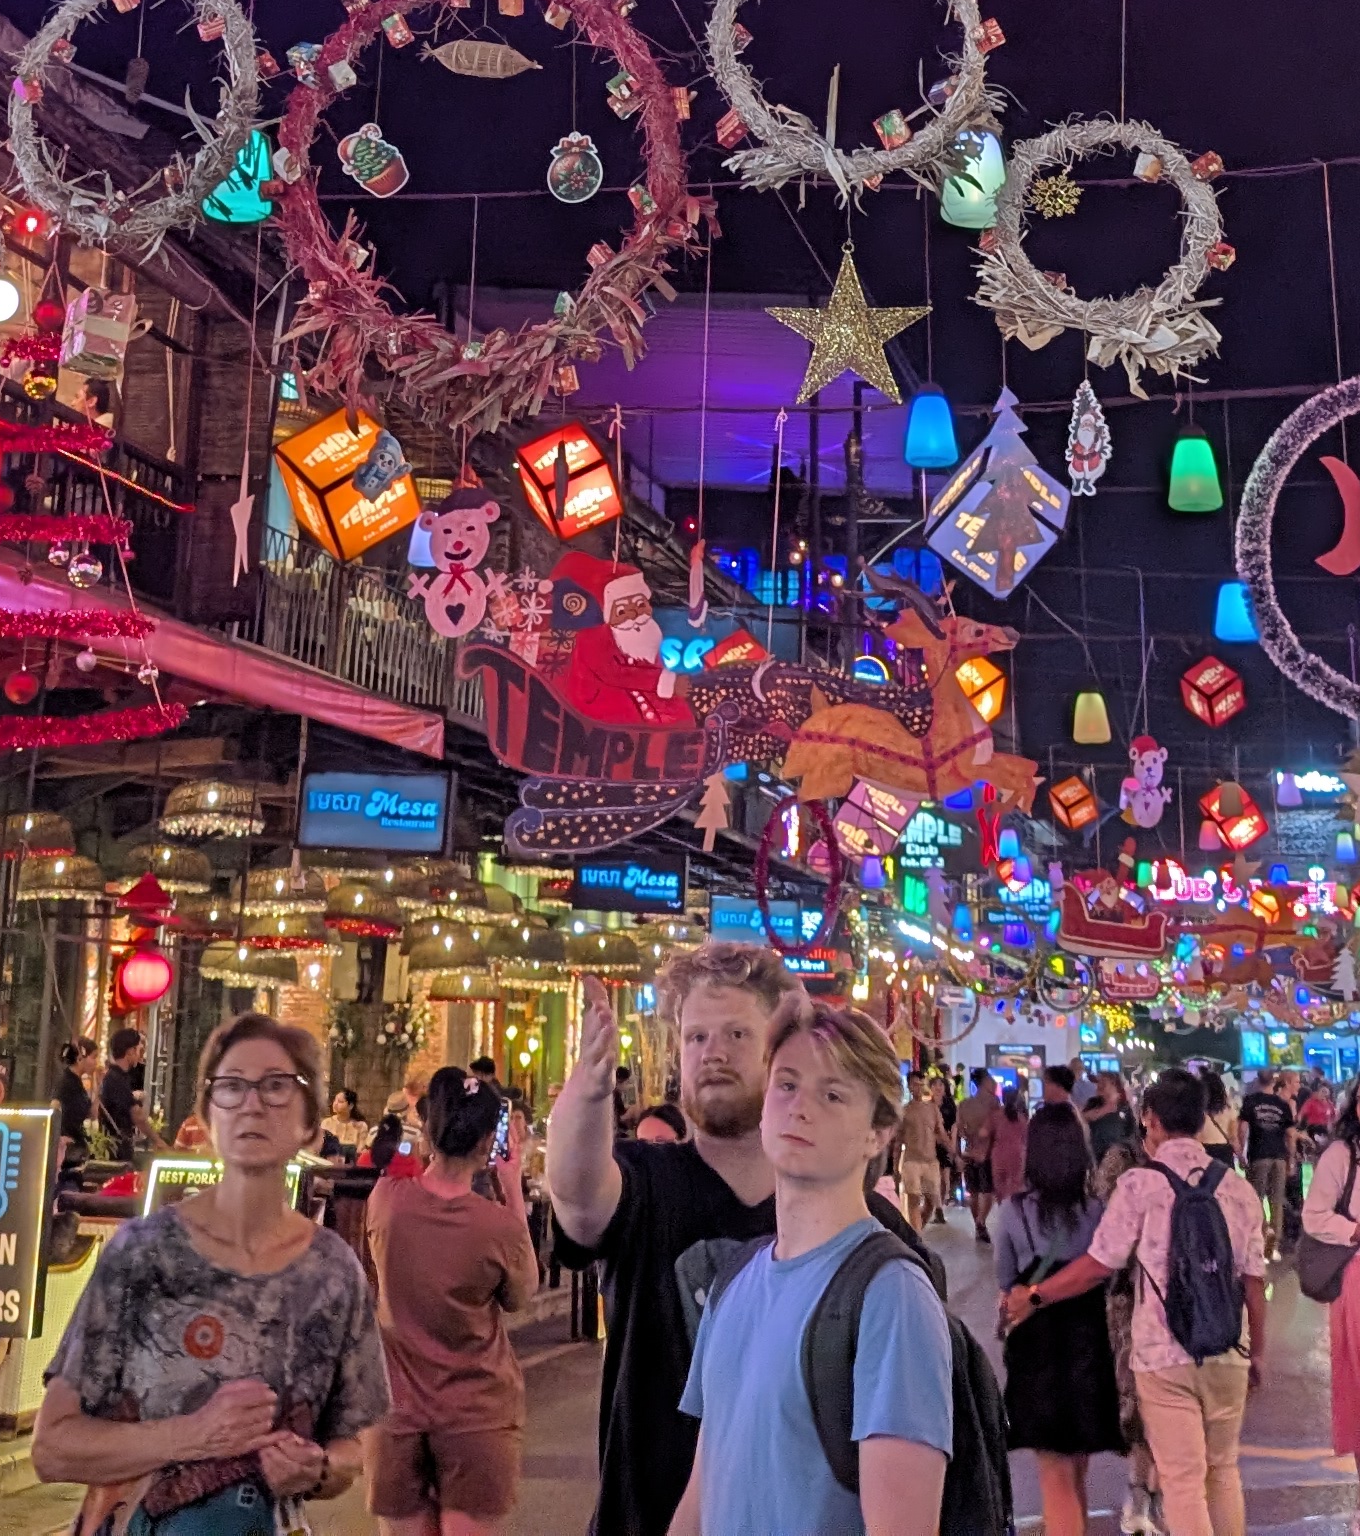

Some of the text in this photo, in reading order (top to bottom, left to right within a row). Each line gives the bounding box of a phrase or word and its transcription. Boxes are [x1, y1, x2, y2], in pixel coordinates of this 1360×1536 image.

[302, 424, 374, 468] TEMPLE
[339, 481, 408, 530] TEMPLE
[494, 667, 706, 781] TEMPLE
[365, 789, 439, 818] Mesa
[380, 816, 436, 831] Restaurant
[899, 812, 963, 846] MPLE
[623, 865, 680, 888] Mesa
[158, 1170, 186, 1184] BEST
[187, 1172, 216, 1185] PORK
